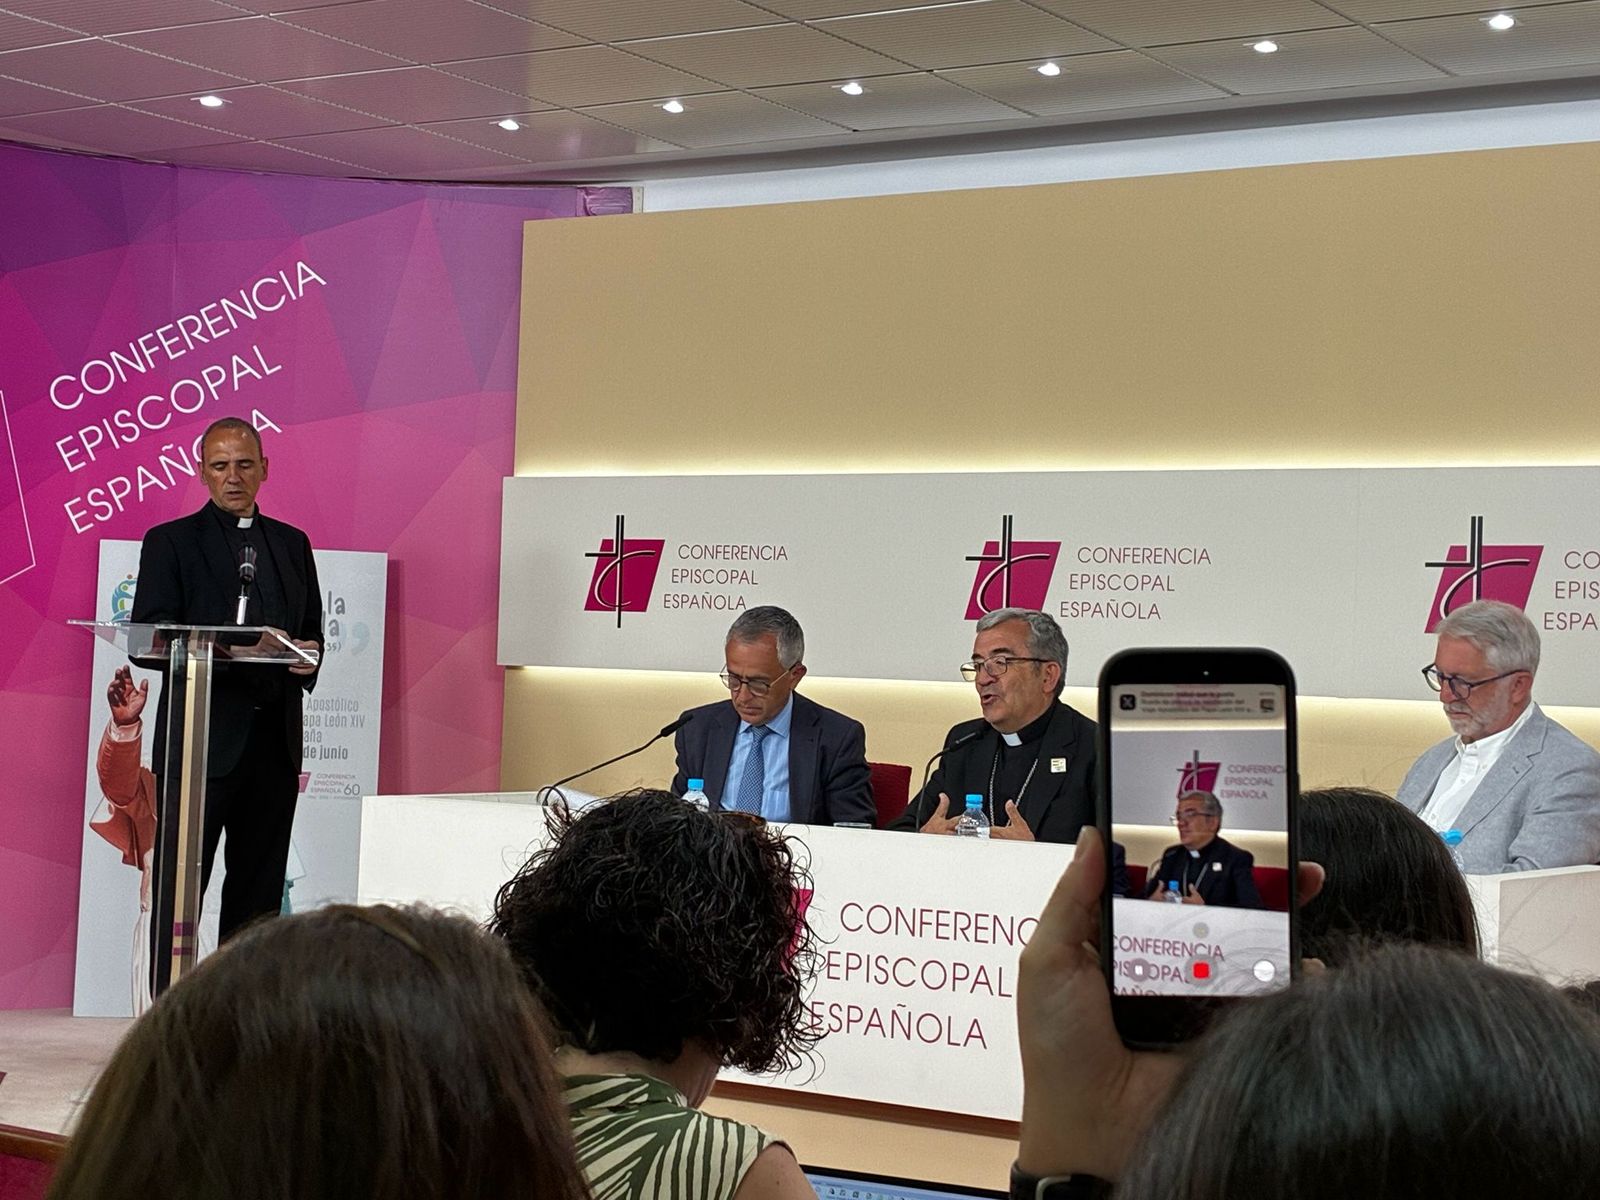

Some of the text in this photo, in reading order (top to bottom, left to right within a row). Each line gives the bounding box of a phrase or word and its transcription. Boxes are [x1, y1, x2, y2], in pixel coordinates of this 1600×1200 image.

[50, 260, 327, 409] CONFERENCIA
[55, 344, 282, 473] EPISCOPAL
[63, 408, 282, 535] ESPAÑA
[678, 544, 788, 561] CONFERENCIA
[1077, 546, 1212, 565] CONFERENCIA
[671, 568, 759, 585] EPISCOPAL
[1069, 573, 1175, 592] EPISCOPAL
[1555, 580, 1600, 600] EPIS
[663, 591, 747, 611] ESPAÑOLA
[1060, 598, 1162, 621] ESPAÑOLA
[1544, 611, 1599, 631] ESPA
[306, 697, 359, 713] Apostólico
[303, 713, 366, 728] apa León XIV
[303, 729, 322, 743] aña
[303, 744, 349, 760] de junio
[343, 783, 361, 796] 60
[826, 950, 1013, 998] EPISCOPAL
[811, 1001, 988, 1050] ESPAÑOLA
